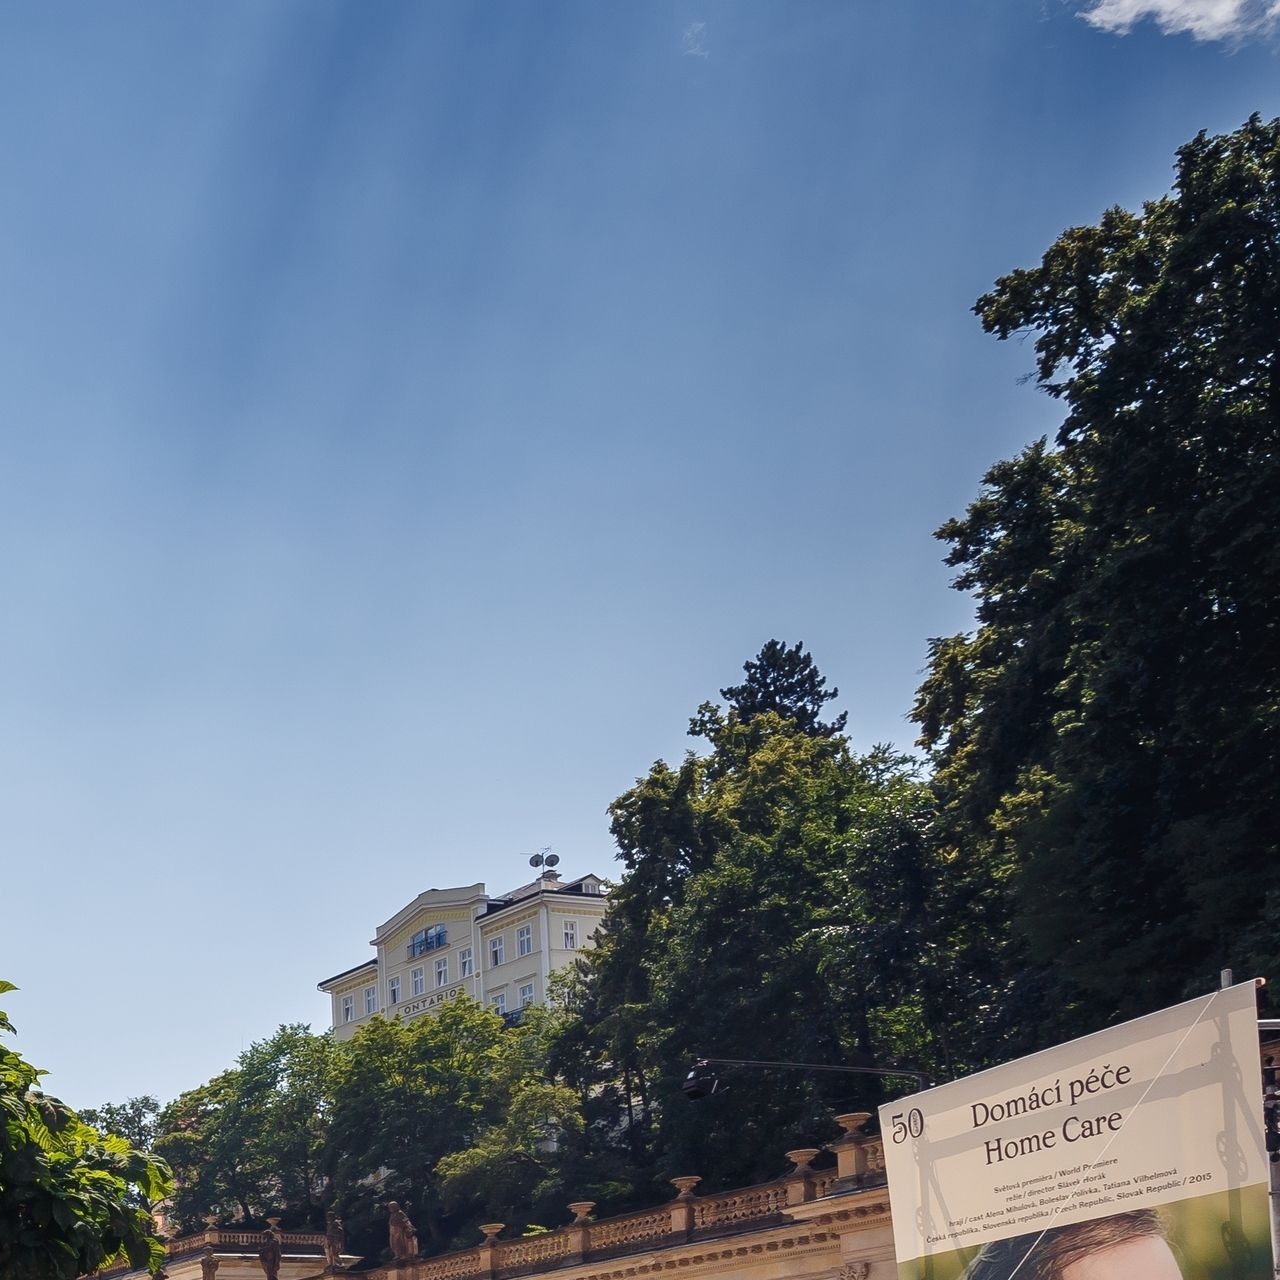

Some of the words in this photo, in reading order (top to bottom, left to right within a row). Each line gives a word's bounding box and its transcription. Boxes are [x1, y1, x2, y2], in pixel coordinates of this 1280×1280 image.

[970, 1079, 1061, 1128] Domácí
[1068, 1063, 1132, 1105] péče
[984, 1128, 1057, 1166] Home
[1062, 1111, 1123, 1143] Care
[1027, 1186, 1055, 1198] director
[1059, 1166, 1080, 1177] World
[1083, 1158, 1118, 1171] Premiere
[969, 1214, 984, 1223] cast
[985, 1209, 1004, 1219] Alena
[1039, 1194, 1069, 1206] Boleslav
[1104, 1179, 1131, 1191] Tatiana
[982, 1218, 1016, 1231] Slovenská
[1017, 1210, 1049, 1223] republika
[1079, 1196, 1115, 1209] Republic,
[1116, 1188, 1144, 1200] Slovak
[1146, 1181, 1181, 1193] Republic
[1188, 1172, 1212, 1184] 2015
